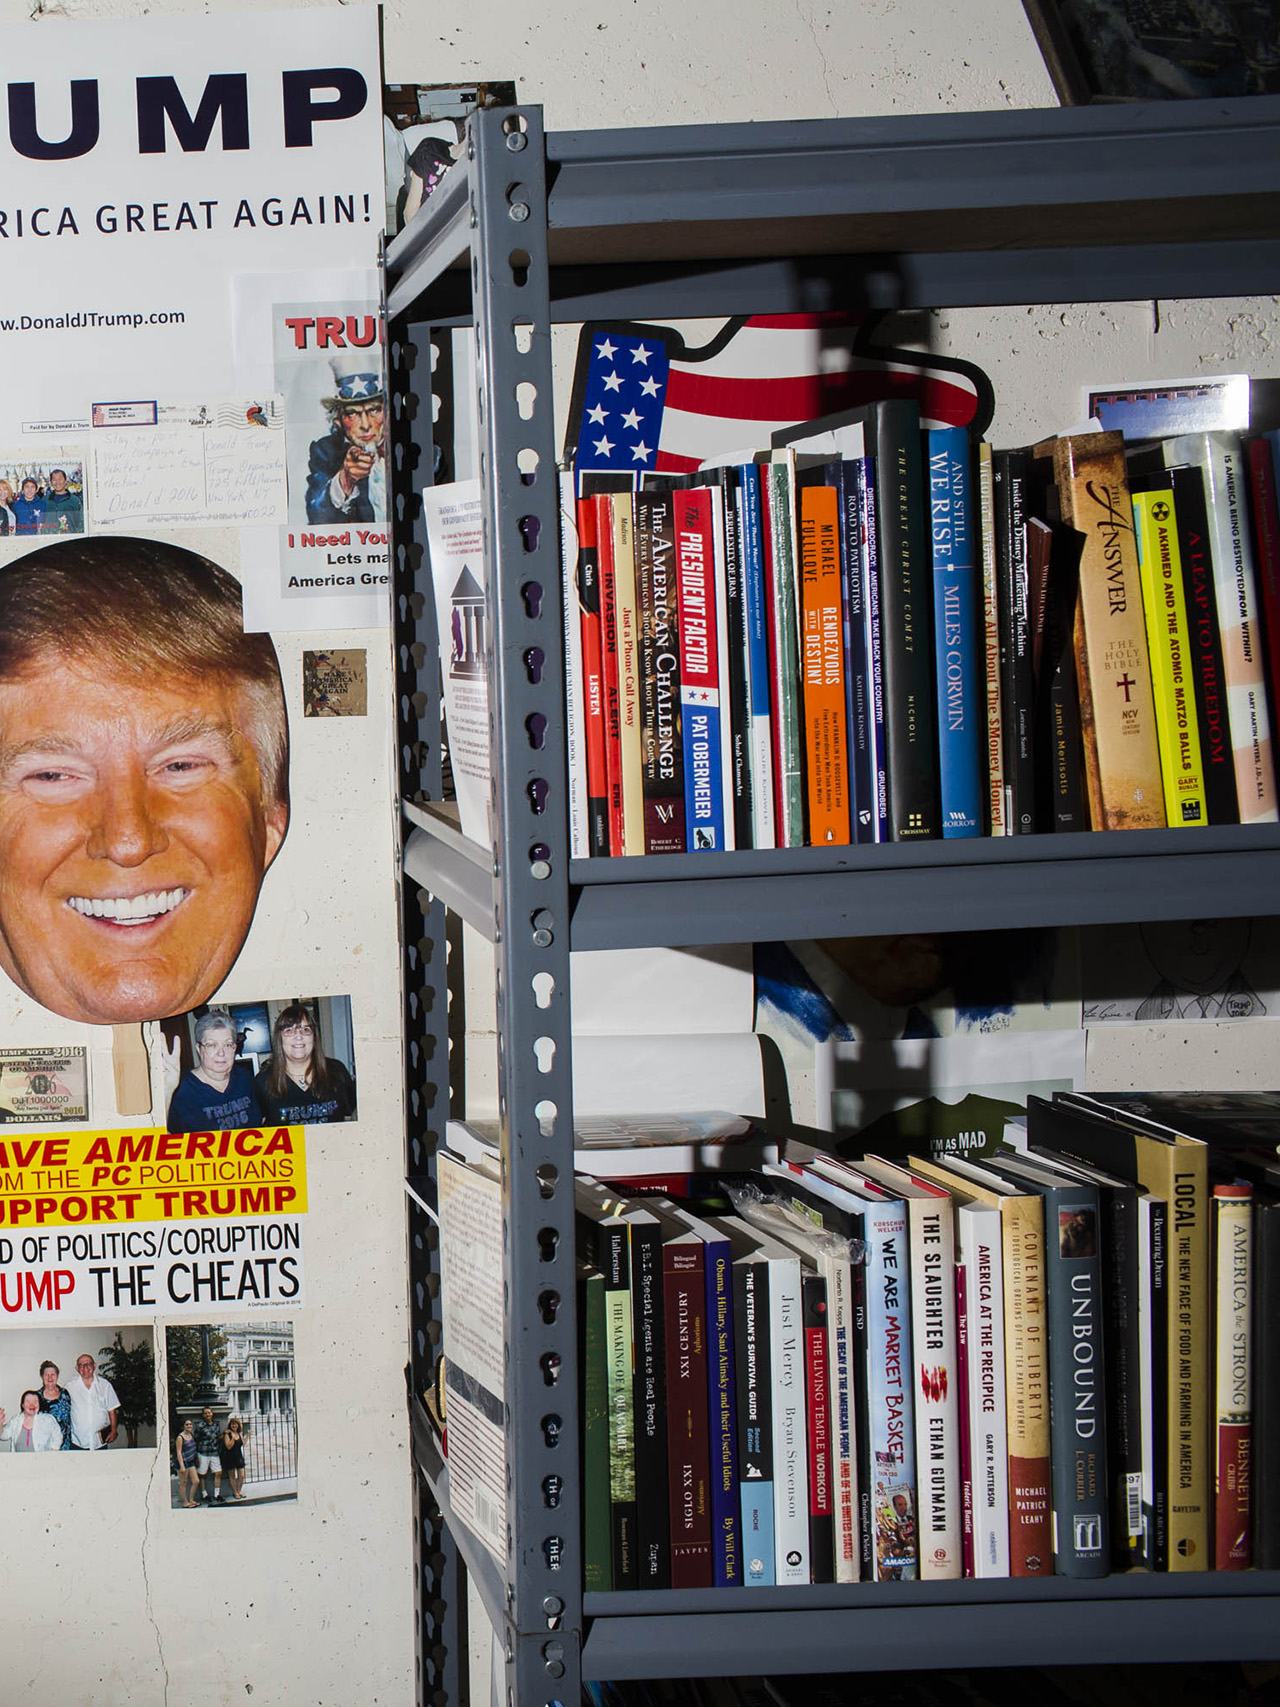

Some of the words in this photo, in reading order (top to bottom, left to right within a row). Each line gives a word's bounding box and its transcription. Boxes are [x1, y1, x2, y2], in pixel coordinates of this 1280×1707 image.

[95, 200, 219, 234] GREAT
[233, 193, 371, 228] AGAIN!
[285, 316, 382, 349] TRU
[930, 451, 949, 491] WE
[951, 461, 964, 496] AND
[1111, 483, 1120, 508] THE
[652, 503, 666, 534] THE
[686, 506, 700, 528] The
[931, 498, 953, 558] RISE
[953, 500, 966, 547] STILL
[288, 533, 295, 548] I
[300, 530, 351, 547] Need
[821, 525, 835, 577] MICHAEL
[1086, 481, 1134, 616] ANSWER
[327, 553, 361, 564] Lets
[680, 531, 706, 613] PRESIDENT
[288, 574, 356, 588] America
[651, 535, 673, 647] AMERICAN
[605, 573, 616, 653] INVASION
[623, 607, 632, 628] Just
[944, 585, 962, 646] MILES
[624, 641, 634, 674] Phone
[683, 617, 709, 674] FACTOR
[822, 607, 840, 685] RENDEZVOUS
[589, 675, 600, 715] LISTEN
[625, 676, 635, 698] Call
[946, 651, 964, 731] CORWIN
[625, 700, 635, 728] Away
[655, 653, 677, 780] CHALLENGE
[691, 715, 708, 740] PAT
[1122, 709, 1138, 720] NCV
[692, 742, 712, 819] OBERMEIER
[5, 1114, 62, 1123] DOLLARS
[203, 1096, 251, 1121] TRUMP
[279, 1100, 338, 1120] TRUMP
[83, 1128, 294, 1165] AMERICA
[930, 1139, 943, 1150] I'M
[945, 1138, 957, 1150] AS
[959, 1130, 986, 1149] MAD
[31, 1169, 80, 1189] THE
[92, 1165, 132, 1187] PC
[140, 1158, 294, 1184] POLITICIANS
[155, 1186, 296, 1217] TRUMP
[1175, 1173, 1195, 1232] LOCAL
[22, 1236, 49, 1263] OF
[58, 1223, 300, 1262] POLITICS/CORUPTION
[923, 1214, 940, 1244] THE
[1179, 1236, 1190, 1256] THE
[611, 1235, 620, 1284] Halberstam
[882, 1238, 898, 1269] WE
[1179, 1258, 1191, 1283] NEW
[89, 1264, 156, 1307] THE
[167, 1257, 300, 1304] CHEATS
[978, 1245, 991, 1301] AMERICA
[781, 1294, 794, 1329] Just
[883, 1275, 899, 1310] ARE
[924, 1254, 944, 1349] SLAUGHTER
[1179, 1284, 1191, 1310] FACE
[856, 1306, 864, 1330] PTSD
[980, 1305, 992, 1320] AT
[1179, 1312, 1191, 1326] OF
[885, 1315, 903, 1388] MARKET
[980, 1322, 993, 1346] THE
[1179, 1328, 1192, 1356] FOOD
[779, 1338, 796, 1390] Mercy
[1071, 1273, 1096, 1439] UNBOUND
[1179, 1358, 1191, 1379] AND
[981, 1351, 995, 1412] PRECIPICE
[1179, 1382, 1192, 1426] FARMING
[782, 1406, 796, 1446] Bryan
[885, 1393, 904, 1464] BASKET
[930, 1418, 945, 1460] ETHAN
[1180, 1430, 1192, 1440] IN
[787, 1451, 797, 1519] Stevenson
[1179, 1443, 1192, 1489] AMERICA
[1237, 1438, 1250, 1515] BENNETT
[861, 1493, 869, 1534] Christopher
[931, 1466, 946, 1532] GUTMANN
